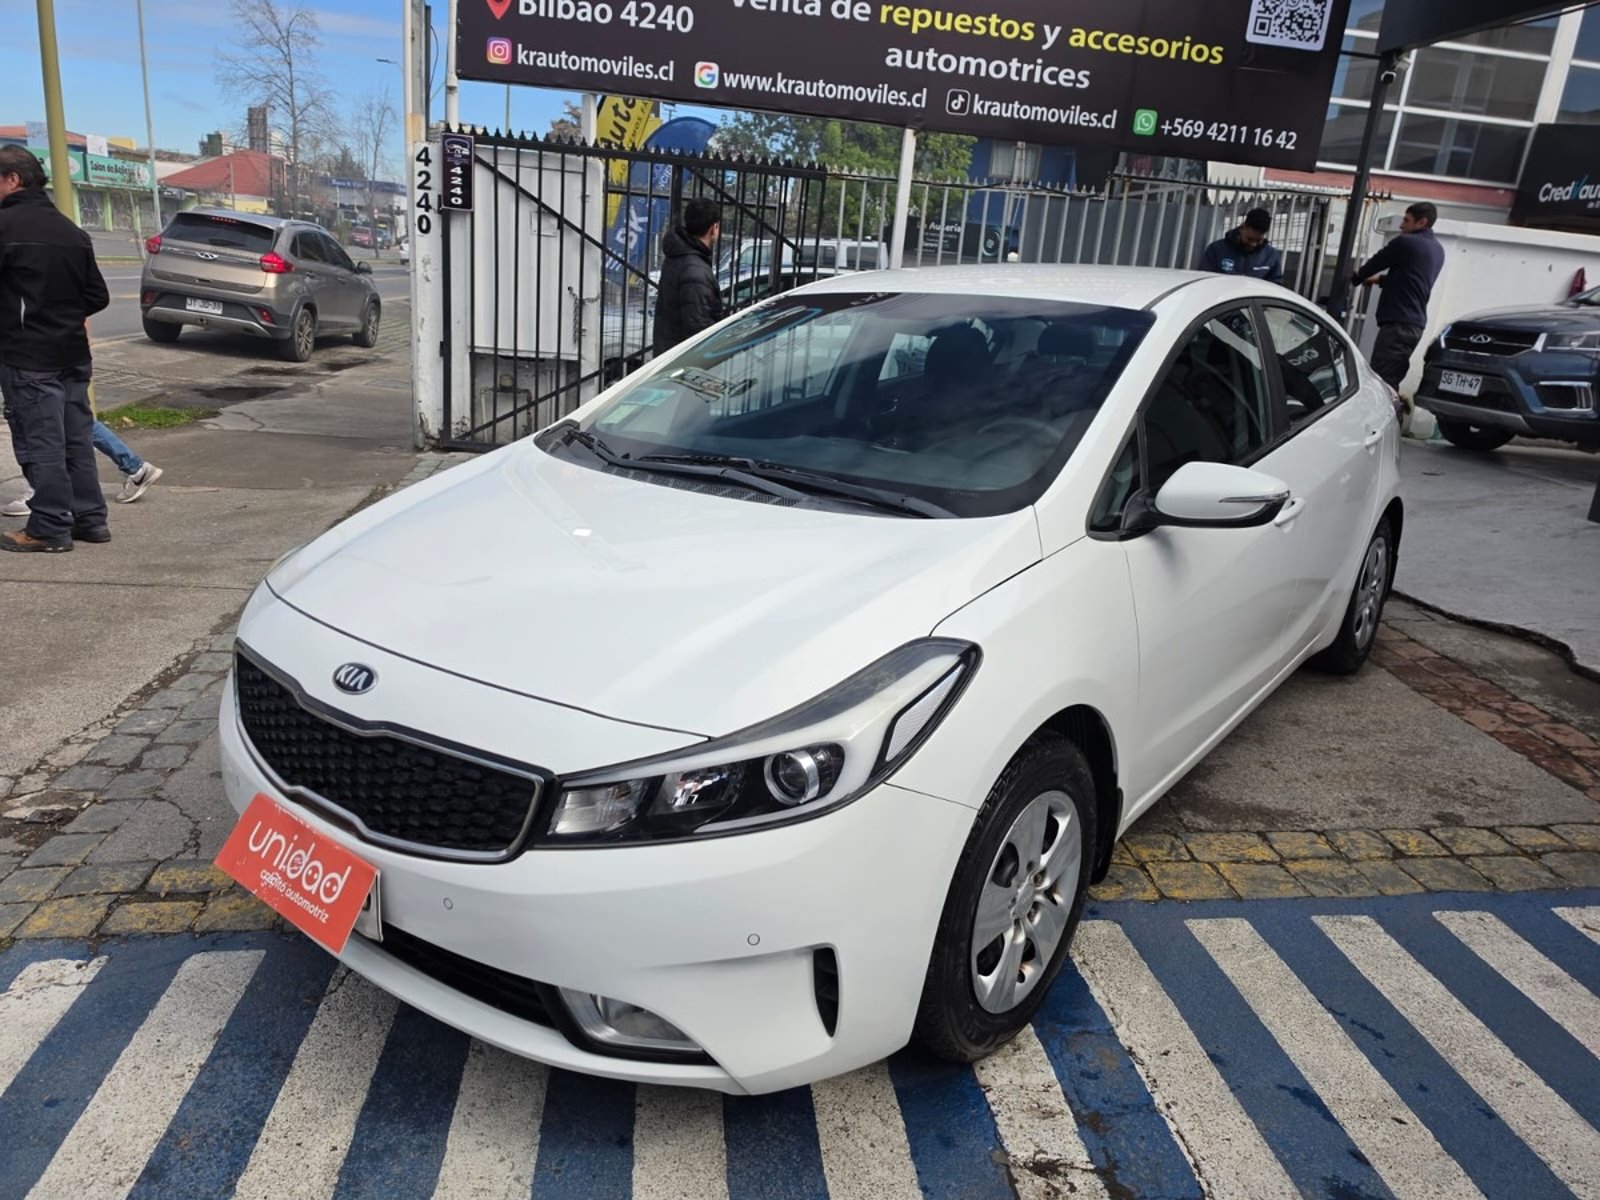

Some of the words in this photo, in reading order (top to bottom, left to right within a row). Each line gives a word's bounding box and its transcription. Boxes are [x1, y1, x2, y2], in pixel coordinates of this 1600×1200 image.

[620, 1, 694, 32] 4240
[830, 0, 872, 21] de
[880, 4, 1035, 41] repuestos
[1041, 24, 1062, 50] y
[1068, 27, 1224, 64] accesorios
[516, 43, 675, 81] krautomoviles.cl
[885, 47, 1091, 88] automotrices
[723, 71, 927, 108] www.krautomoviles.cl
[973, 94, 1117, 129] krautomoviles.cl
[1160, 118, 1204, 139] +569
[1206, 122, 1247, 144] 4211
[1253, 127, 1273, 147] 16
[1275, 131, 1297, 150] 42
[416, 146, 432, 235] 4240
[450, 166, 463, 205] 4240
[336, 664, 369, 690] KIA
[248, 821, 351, 904] unidad
[285, 886, 330, 924] automotriz
